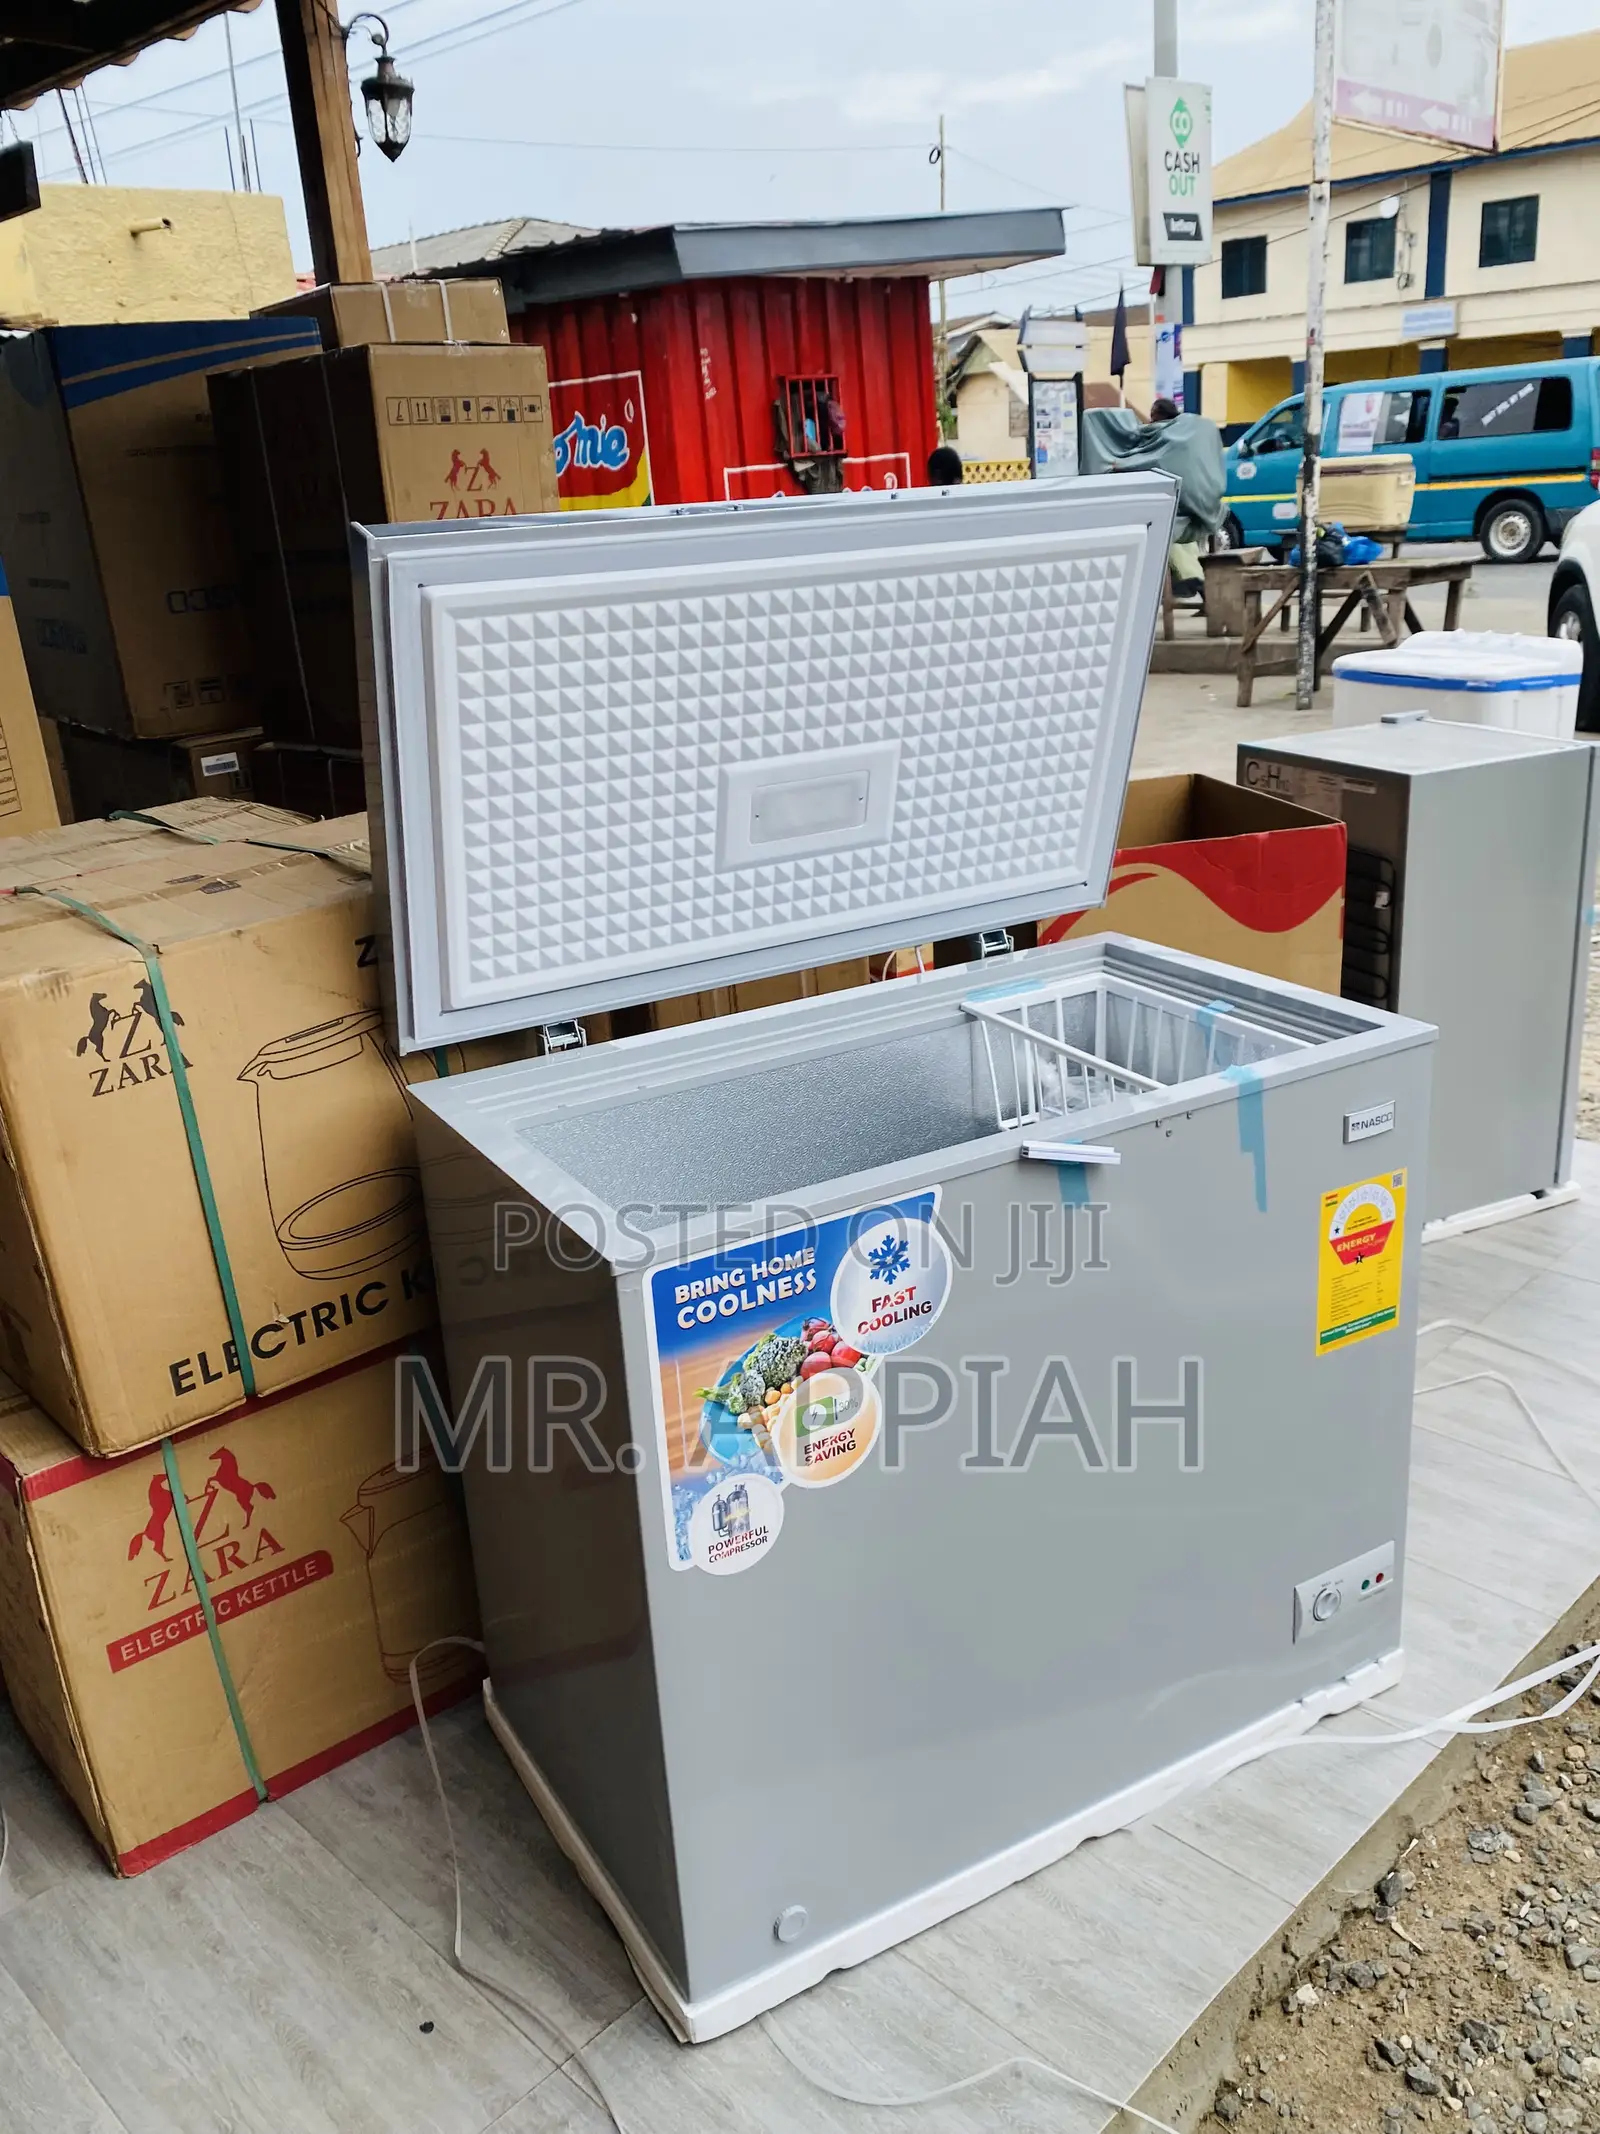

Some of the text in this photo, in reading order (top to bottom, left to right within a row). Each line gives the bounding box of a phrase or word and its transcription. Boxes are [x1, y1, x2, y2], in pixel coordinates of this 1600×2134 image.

[1164, 150, 1200, 173] CASH
[1169, 174, 1196, 196] OUT
[1360, 1112, 1393, 1130] NASCO
[1336, 1233, 1377, 1253] ENERGY
[674, 1246, 816, 1305] BRING HOME
[676, 1269, 818, 1330] COOLNESS
[871, 1285, 917, 1313] FAST
[857, 1300, 932, 1335] COOLING
[169, 1281, 389, 1396] ELECTRIC
[804, 1428, 856, 1455] ENERGY
[804, 1440, 857, 1467] SAVING
[707, 1526, 769, 1555] POWERFUL
[708, 1536, 769, 1564] COMPRESSOR
[120, 1559, 318, 1661] ELECTRC KETTLE
